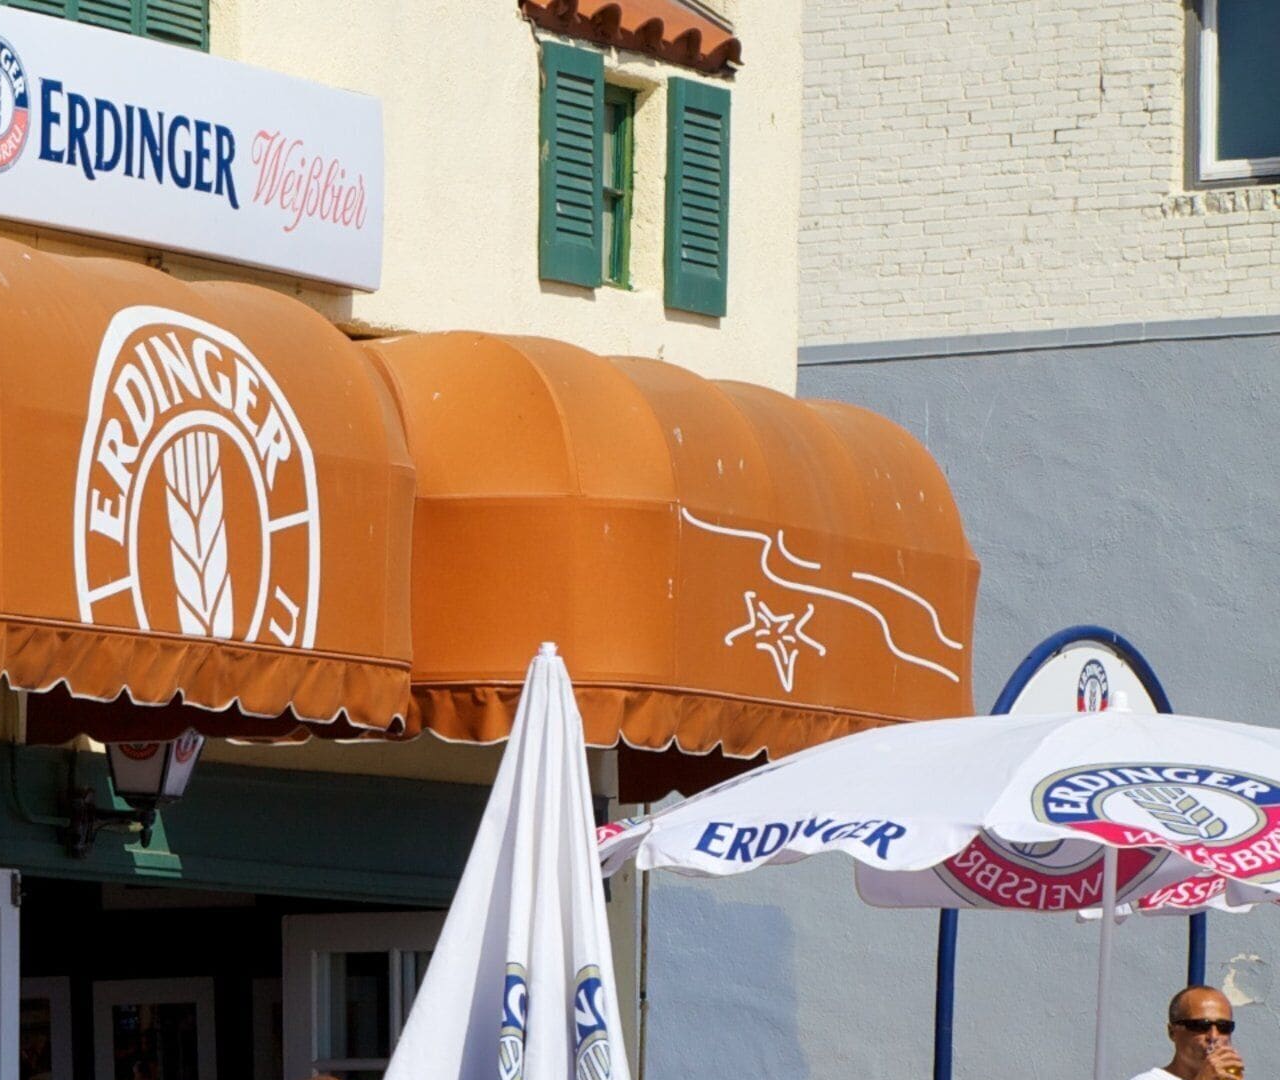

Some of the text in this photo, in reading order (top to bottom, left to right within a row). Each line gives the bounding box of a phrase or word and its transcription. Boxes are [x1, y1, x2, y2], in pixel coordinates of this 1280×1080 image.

[39, 76, 240, 210] ERDINGER
[90, 332, 291, 546] ERDINGER
[1049, 767, 1271, 815] ERDINGER
